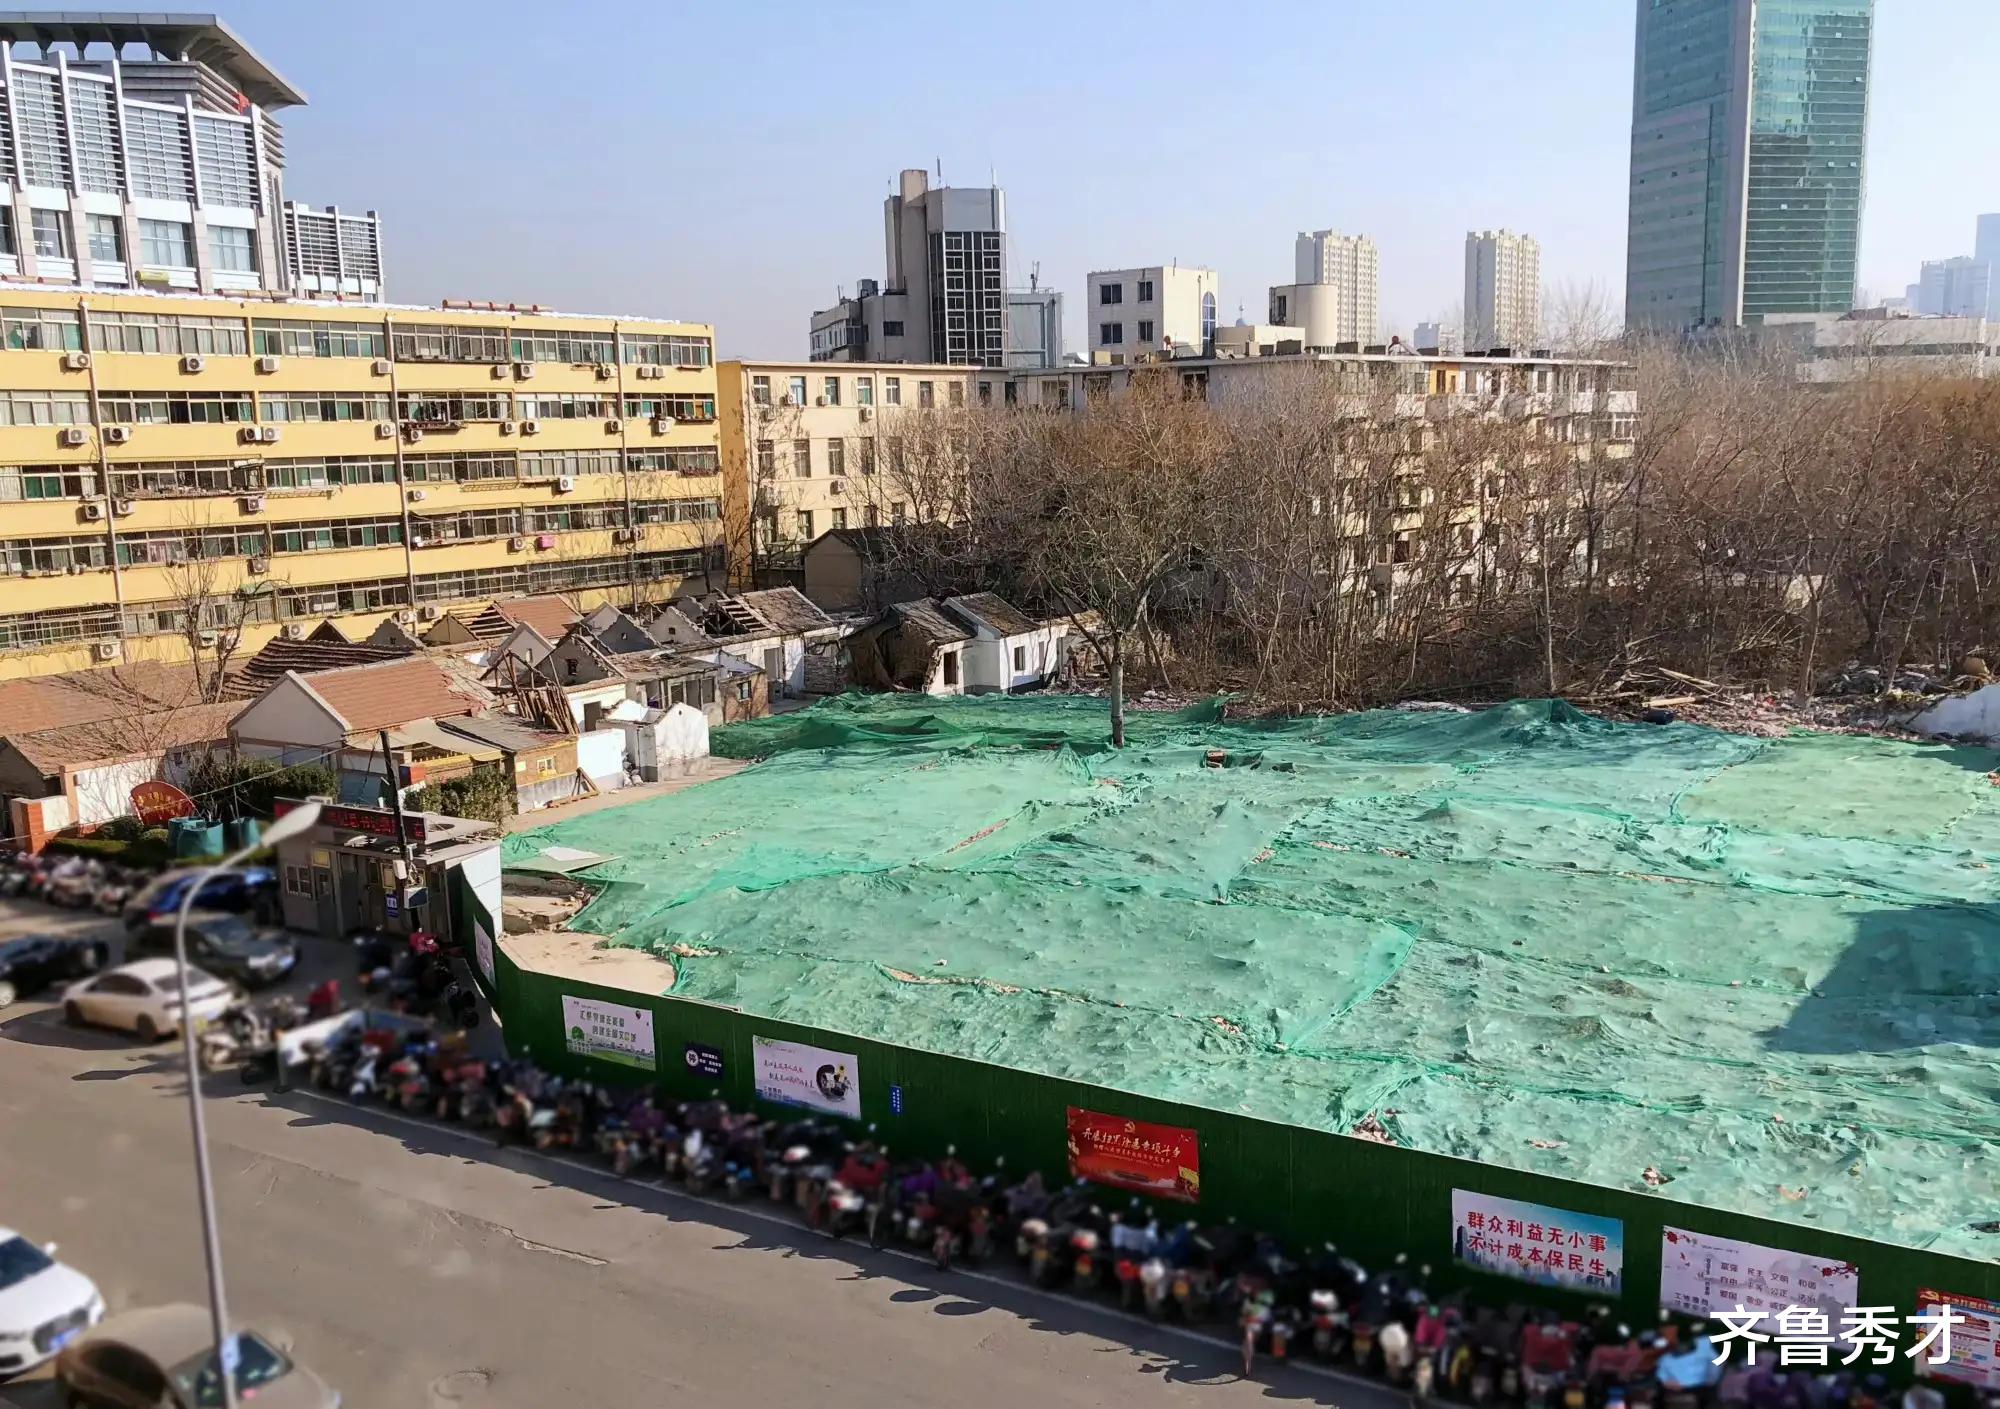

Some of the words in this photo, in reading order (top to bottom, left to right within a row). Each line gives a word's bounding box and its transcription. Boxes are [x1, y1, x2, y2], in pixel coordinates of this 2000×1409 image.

[1082, 1127, 1180, 1158] 开展扫黑除恶专项斗争
[1467, 1211, 1606, 1252] 群众利益无小事
[1468, 1234, 1606, 1277] 不计成本保民生
